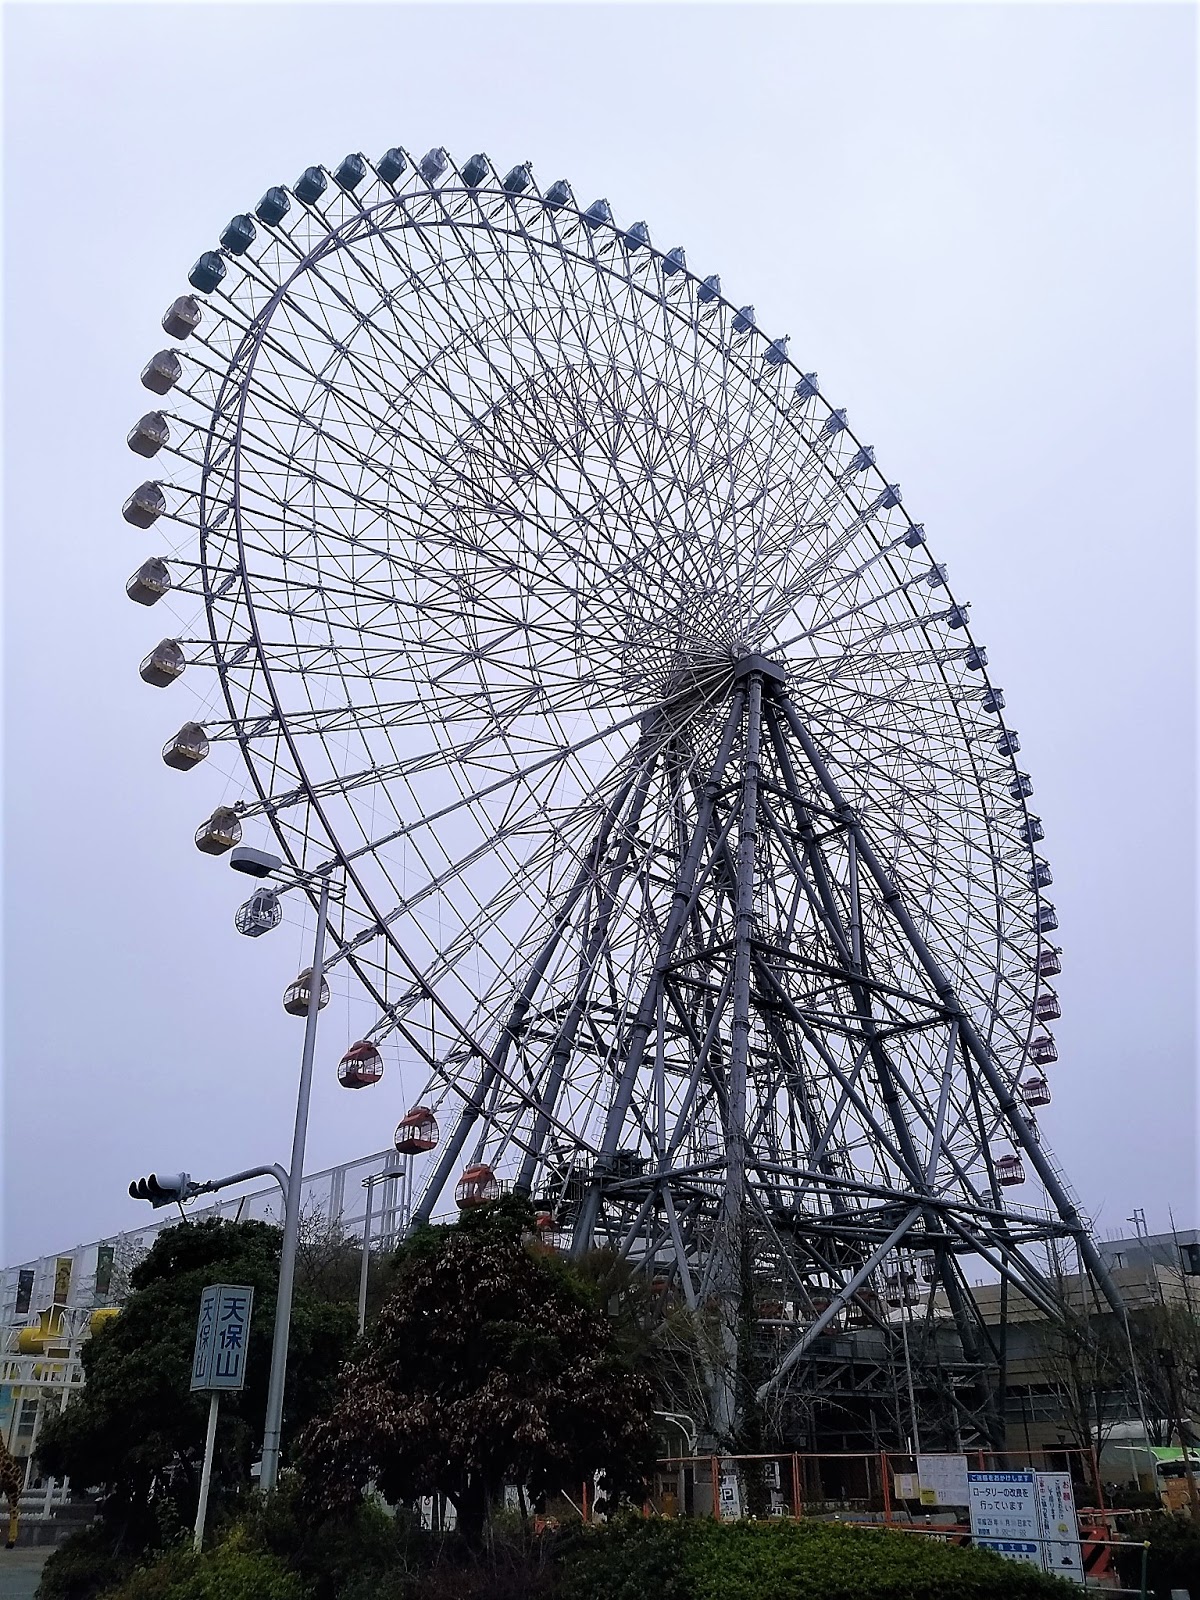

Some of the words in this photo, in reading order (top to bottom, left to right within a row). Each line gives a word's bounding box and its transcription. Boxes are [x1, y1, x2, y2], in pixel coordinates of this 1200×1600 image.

[195, 1297, 214, 1378] 天保山
[216, 1297, 247, 1377] 天保山
[723, 1489, 732, 1501] P
[973, 1487, 1029, 1498] ロータリーの改良を
[980, 1500, 1024, 1511] 行っています
